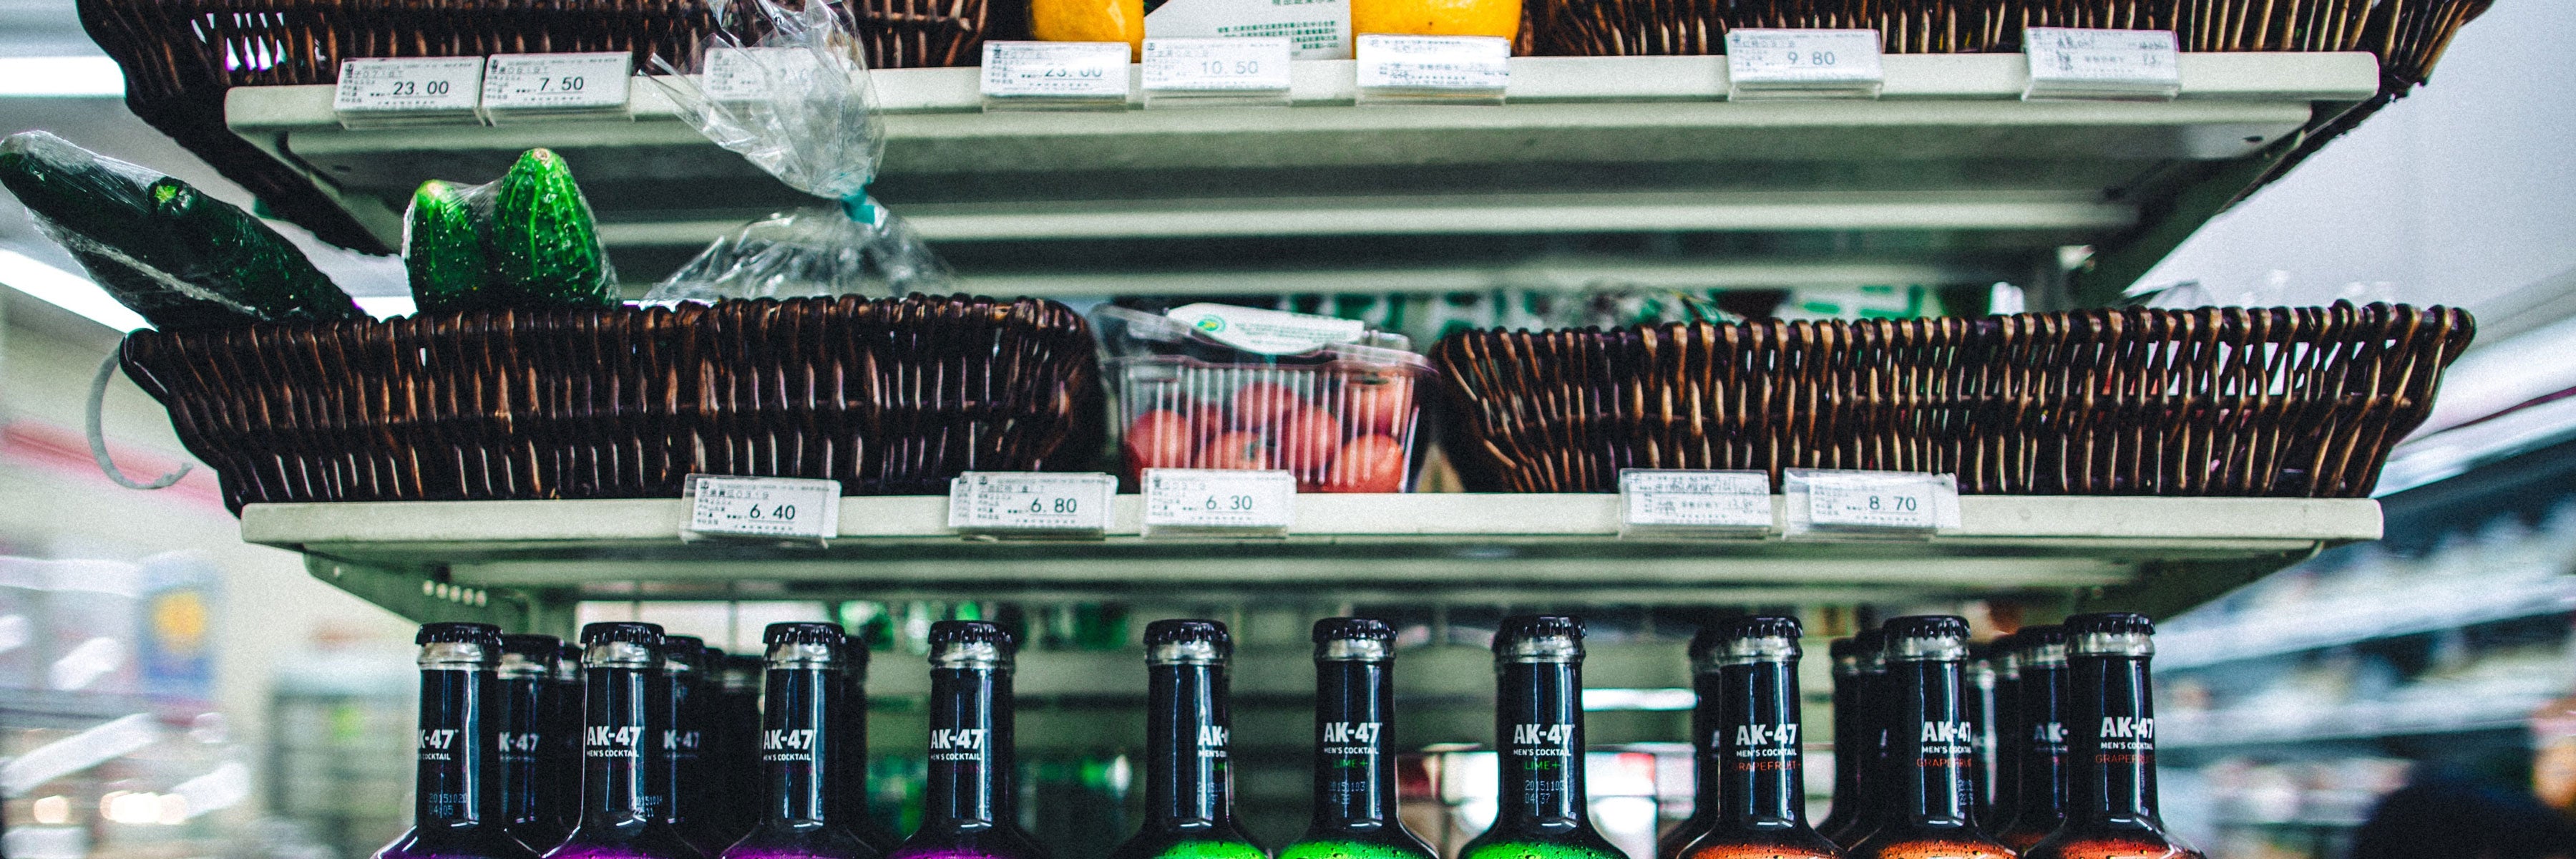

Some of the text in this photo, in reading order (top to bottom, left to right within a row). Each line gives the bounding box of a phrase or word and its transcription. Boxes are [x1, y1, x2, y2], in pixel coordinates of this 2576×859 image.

[1200, 60, 1259, 74] 10.50
[394, 80, 449, 96] 23.00
[540, 76, 584, 92] 7.50
[750, 503, 796, 520] 6.40
[1030, 498, 1077, 513] 6.80
[1206, 495, 1252, 510] 6.30
[1869, 495, 1917, 512] 8.70
[587, 726, 642, 746] AK-47
[1324, 722, 1380, 743] AK-47
[1513, 724, 1573, 744] AK-47
[1735, 724, 1797, 745] AK-47
[2099, 717, 2154, 739] AK-47
[763, 729, 814, 749] AK-47
[930, 729, 986, 749] AK-47
